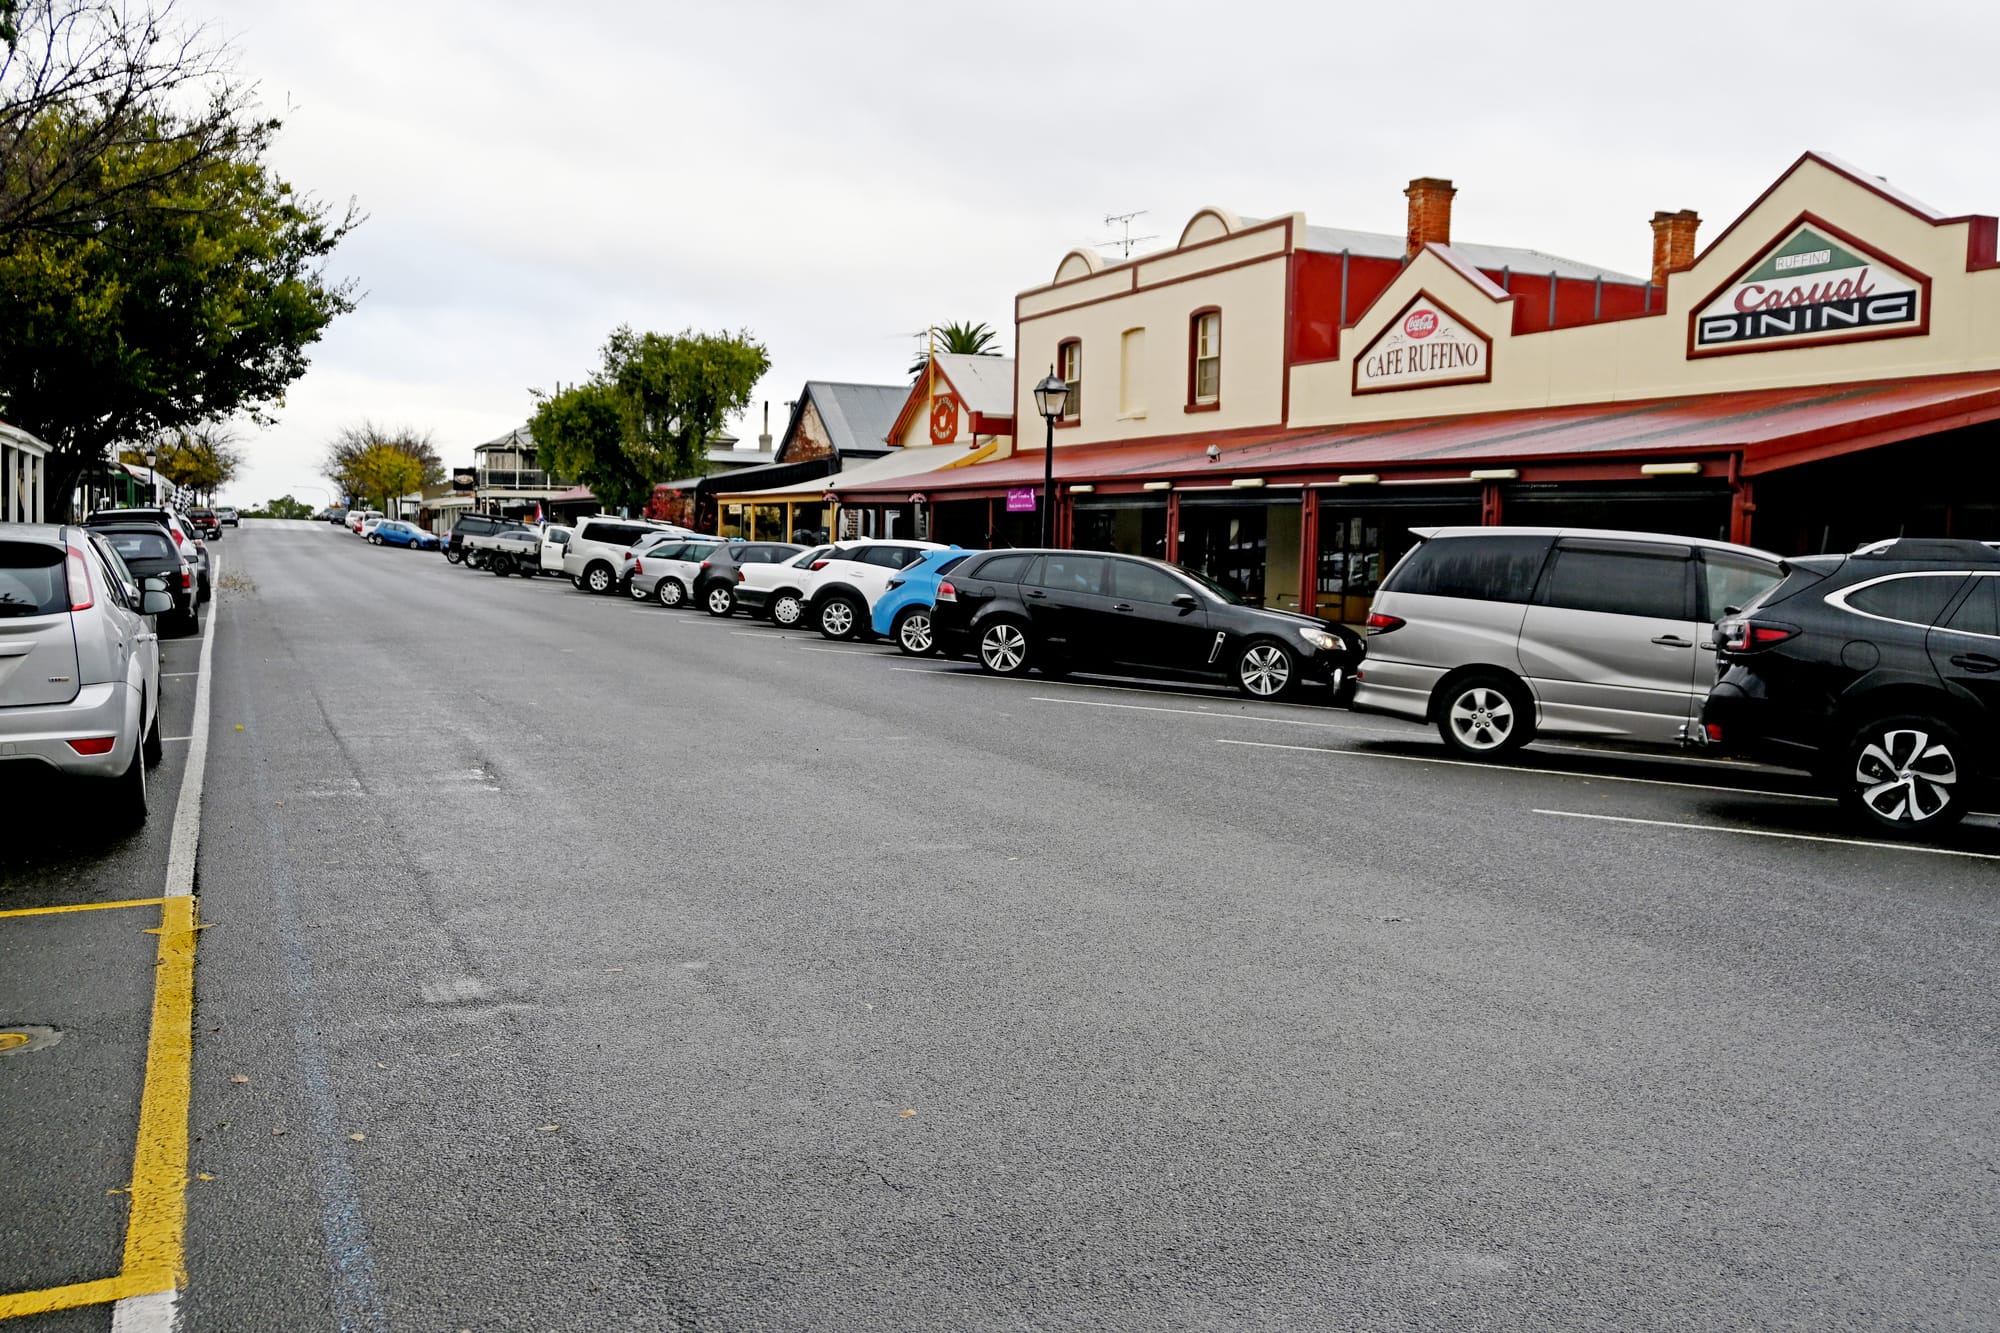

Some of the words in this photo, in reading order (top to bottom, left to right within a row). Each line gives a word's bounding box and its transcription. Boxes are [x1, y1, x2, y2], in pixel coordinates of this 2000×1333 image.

[1777, 250, 1829, 268] RUFFINO
[1734, 267, 1876, 313] Casual
[1703, 296, 1908, 340] DINING
[1366, 348, 1403, 378] CAFE
[1408, 342, 1478, 373] RUFFINO
